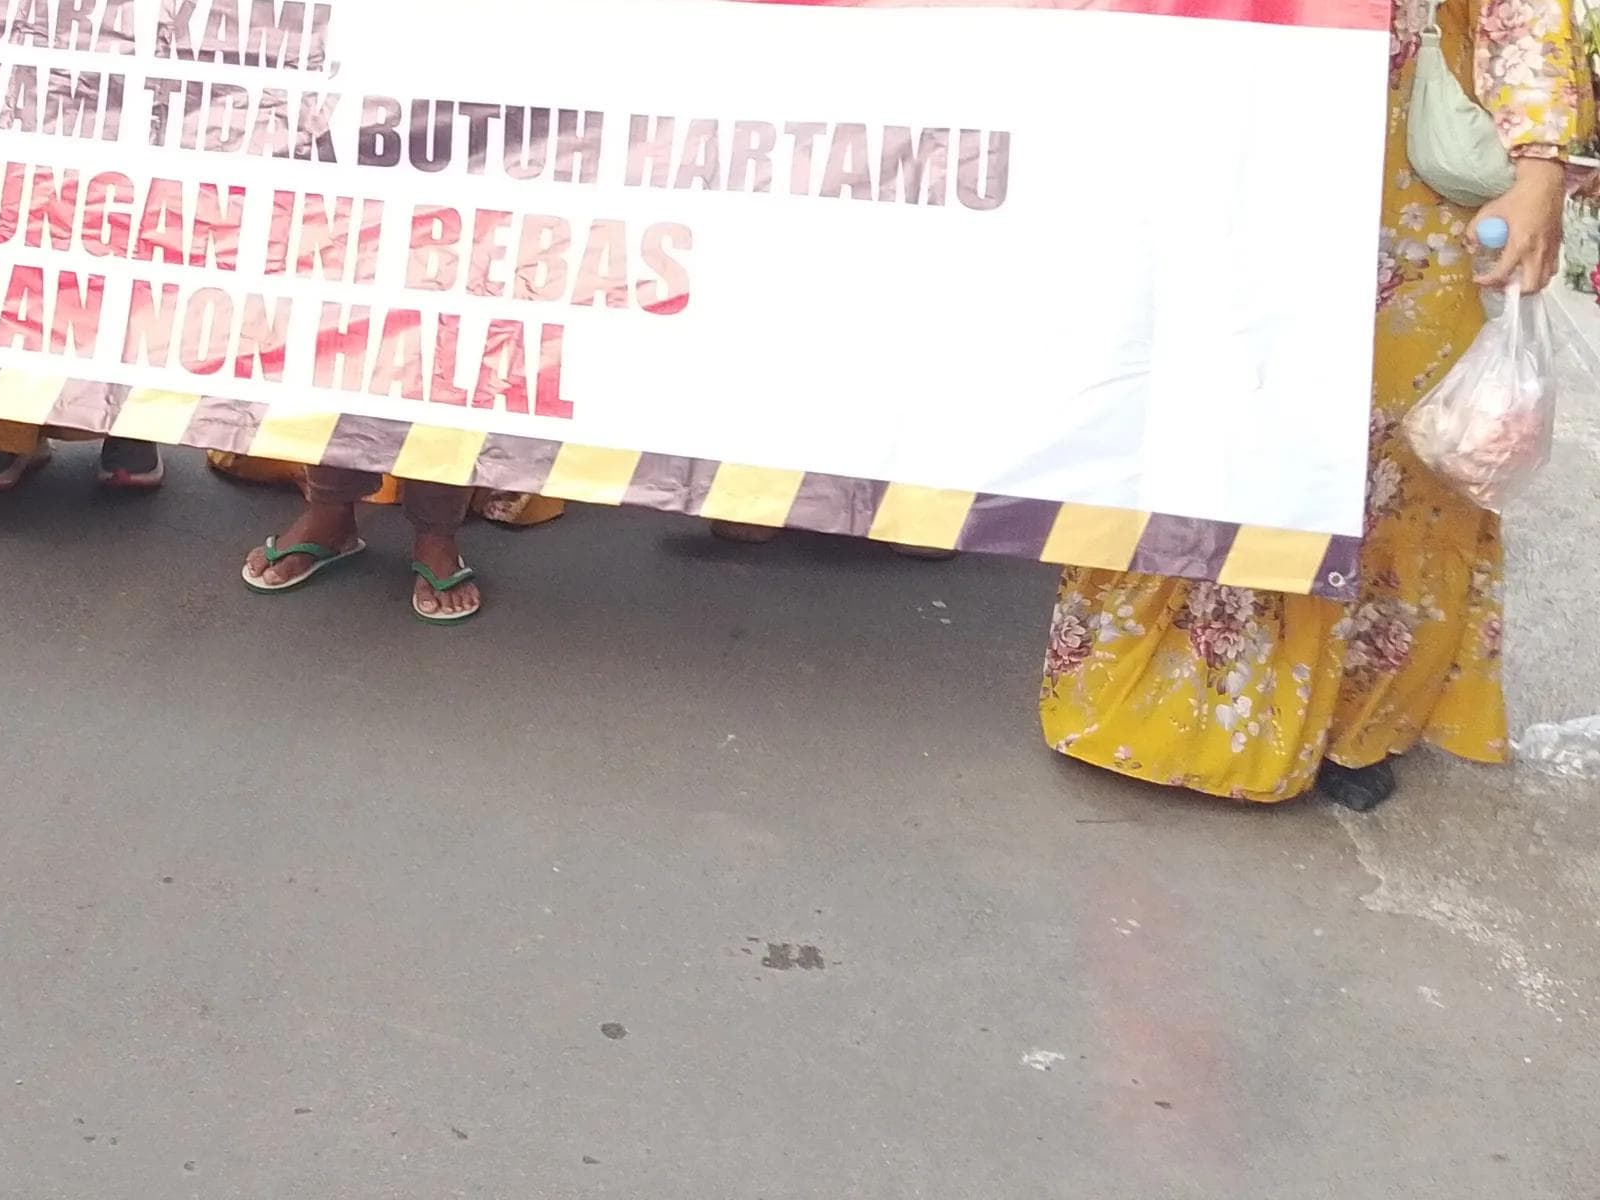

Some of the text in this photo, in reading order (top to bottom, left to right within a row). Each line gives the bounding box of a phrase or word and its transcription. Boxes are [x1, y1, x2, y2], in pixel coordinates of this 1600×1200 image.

[144, 76, 346, 164] TIDAK
[357, 94, 604, 185] BUTUH
[624, 113, 1012, 211] HARTAMU
[263, 189, 381, 286] INI
[404, 203, 694, 316] BEBAS
[121, 277, 293, 383] NON
[312, 301, 575, 421] HALAL
